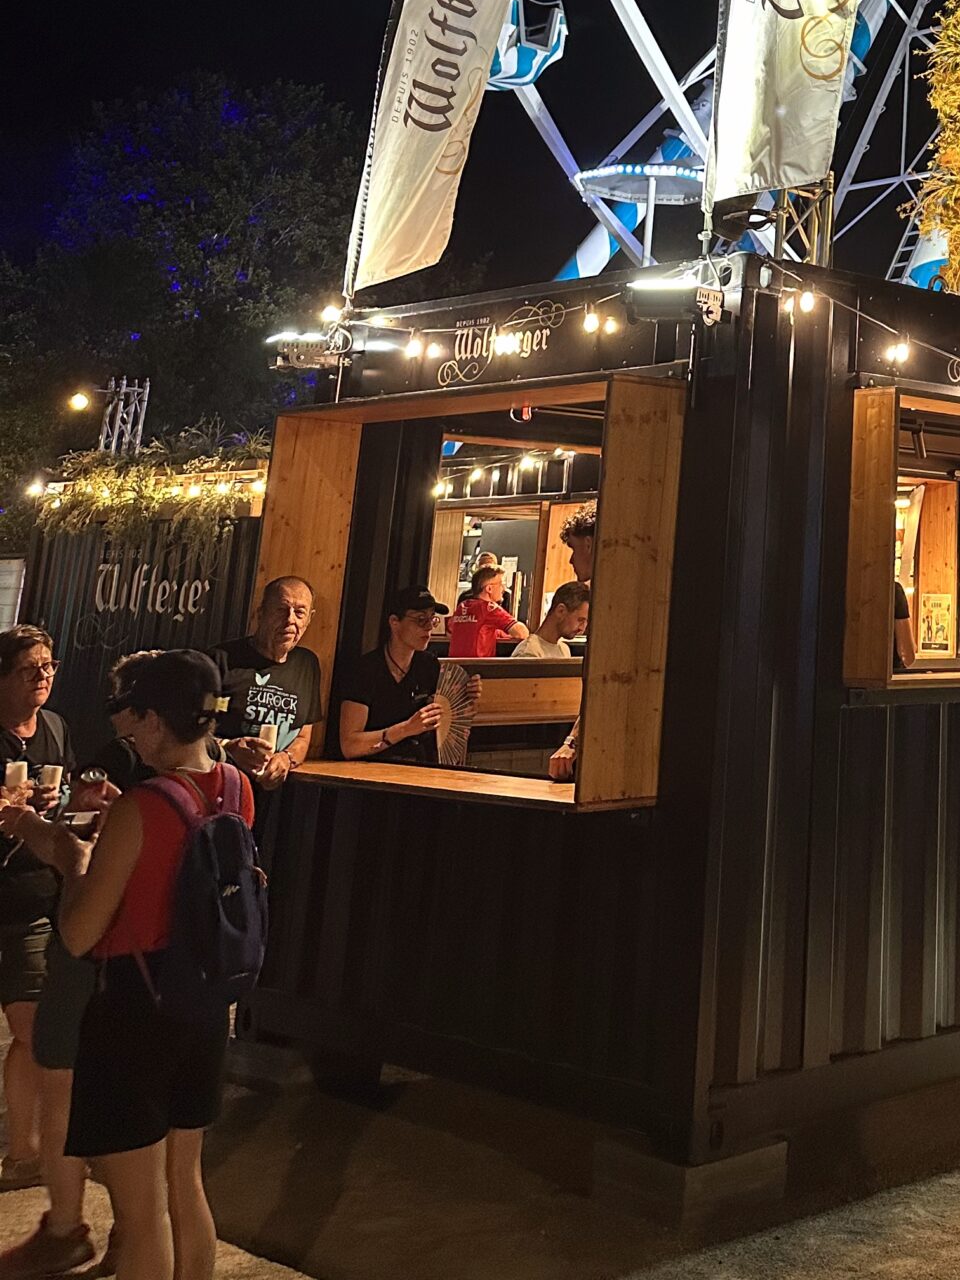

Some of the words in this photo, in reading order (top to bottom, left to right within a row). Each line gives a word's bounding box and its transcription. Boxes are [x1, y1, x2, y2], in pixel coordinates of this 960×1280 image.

[391, 72, 410, 124] DEPUIS
[405, 29, 420, 64] 1902
[454, 324, 551, 364] Wolfrger
[245, 705, 296, 725] STAFF
